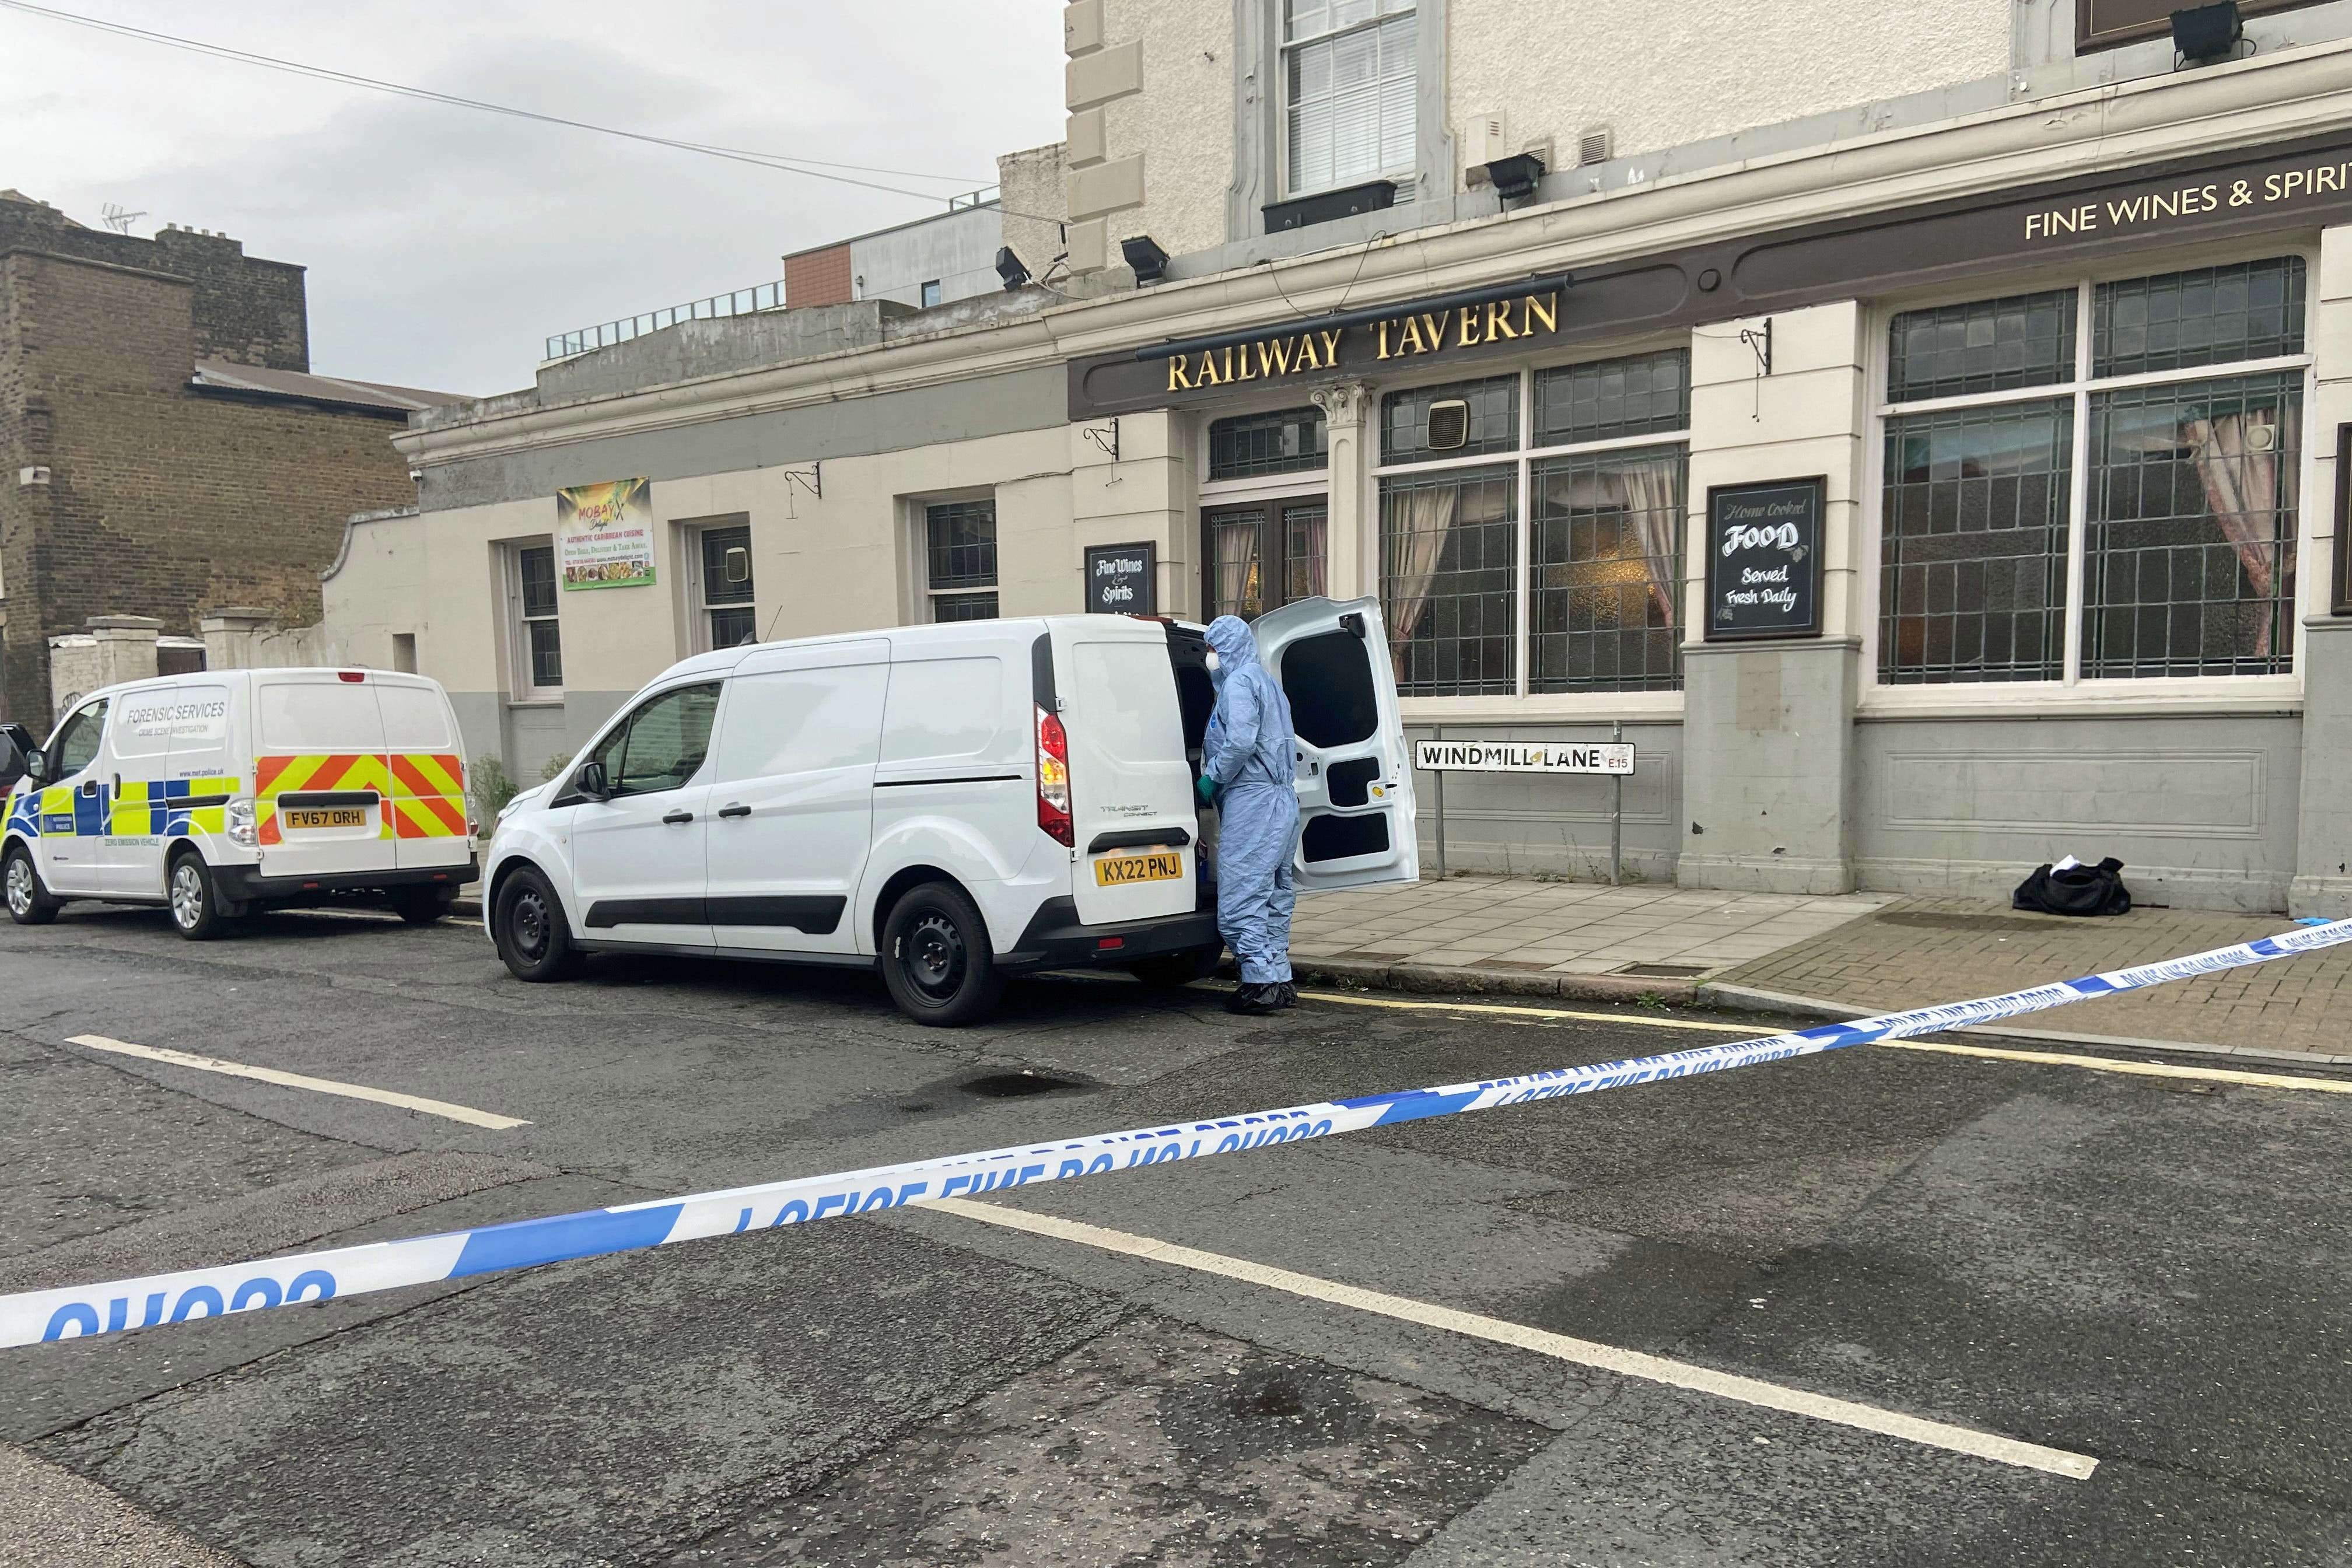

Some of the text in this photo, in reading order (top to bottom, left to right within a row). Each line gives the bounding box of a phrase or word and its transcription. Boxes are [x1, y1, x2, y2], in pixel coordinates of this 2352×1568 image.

[2025, 204, 2097, 240] FINE
[2106, 185, 2218, 226] WINES
[2228, 180, 2254, 207] &
[1167, 292, 1557, 392] RAILWAY TAVERN
[579, 503, 615, 520] MOBAY
[1724, 499, 1807, 520] Home Cooked
[568, 529, 644, 544] AUTHENTIC CARIBBEAN CUISINE
[1722, 522, 1799, 557] FOOD
[1096, 558, 1143, 577] Fine Wines
[1741, 565, 1790, 585] Served
[1112, 574, 1128, 585] &
[1102, 585, 1133, 604] Spirits
[1725, 586, 1797, 612] Fresh Daily
[127, 702, 225, 724] FORENSIC SERVICES
[139, 724, 209, 737] CRIME SCENE INVESTIGATION
[1423, 747, 1533, 765] WINDMILL
[1544, 749, 1600, 767] LANE
[180, 767, 224, 778] www.met.police.uk
[292, 811, 360, 825] FV67 ORH
[140, 838, 159, 846] VEHICLE
[1103, 856, 1177, 882] KX22 PNJ
